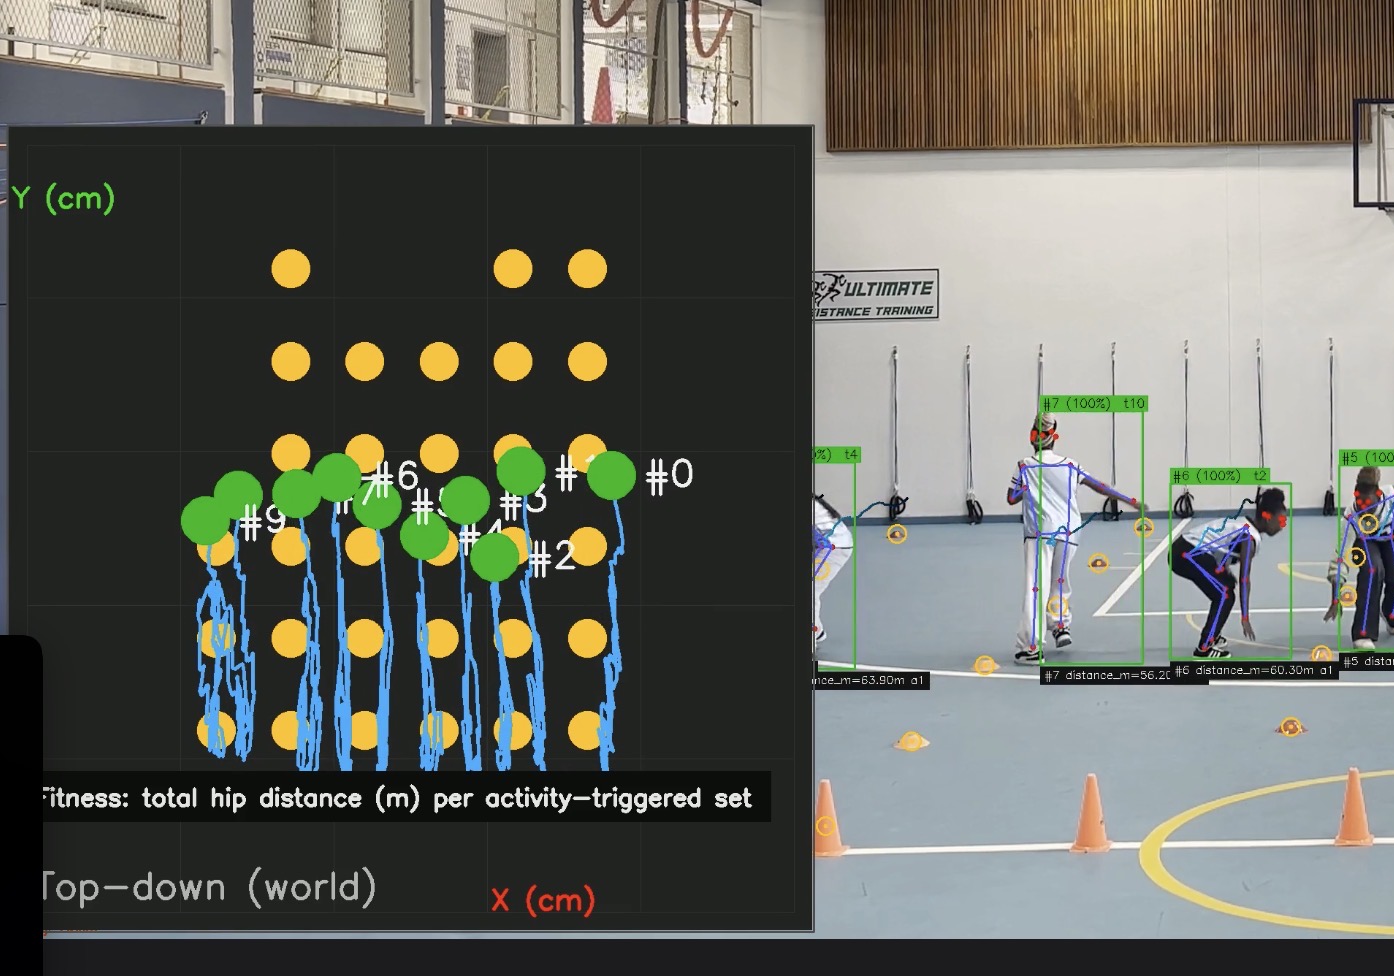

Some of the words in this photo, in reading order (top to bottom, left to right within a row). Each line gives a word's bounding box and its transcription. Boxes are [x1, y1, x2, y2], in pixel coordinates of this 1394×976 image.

[844, 281, 934, 296] ULTIMATE
[812, 306, 871, 317] ISTANCE
[876, 306, 934, 316] TRAINING
